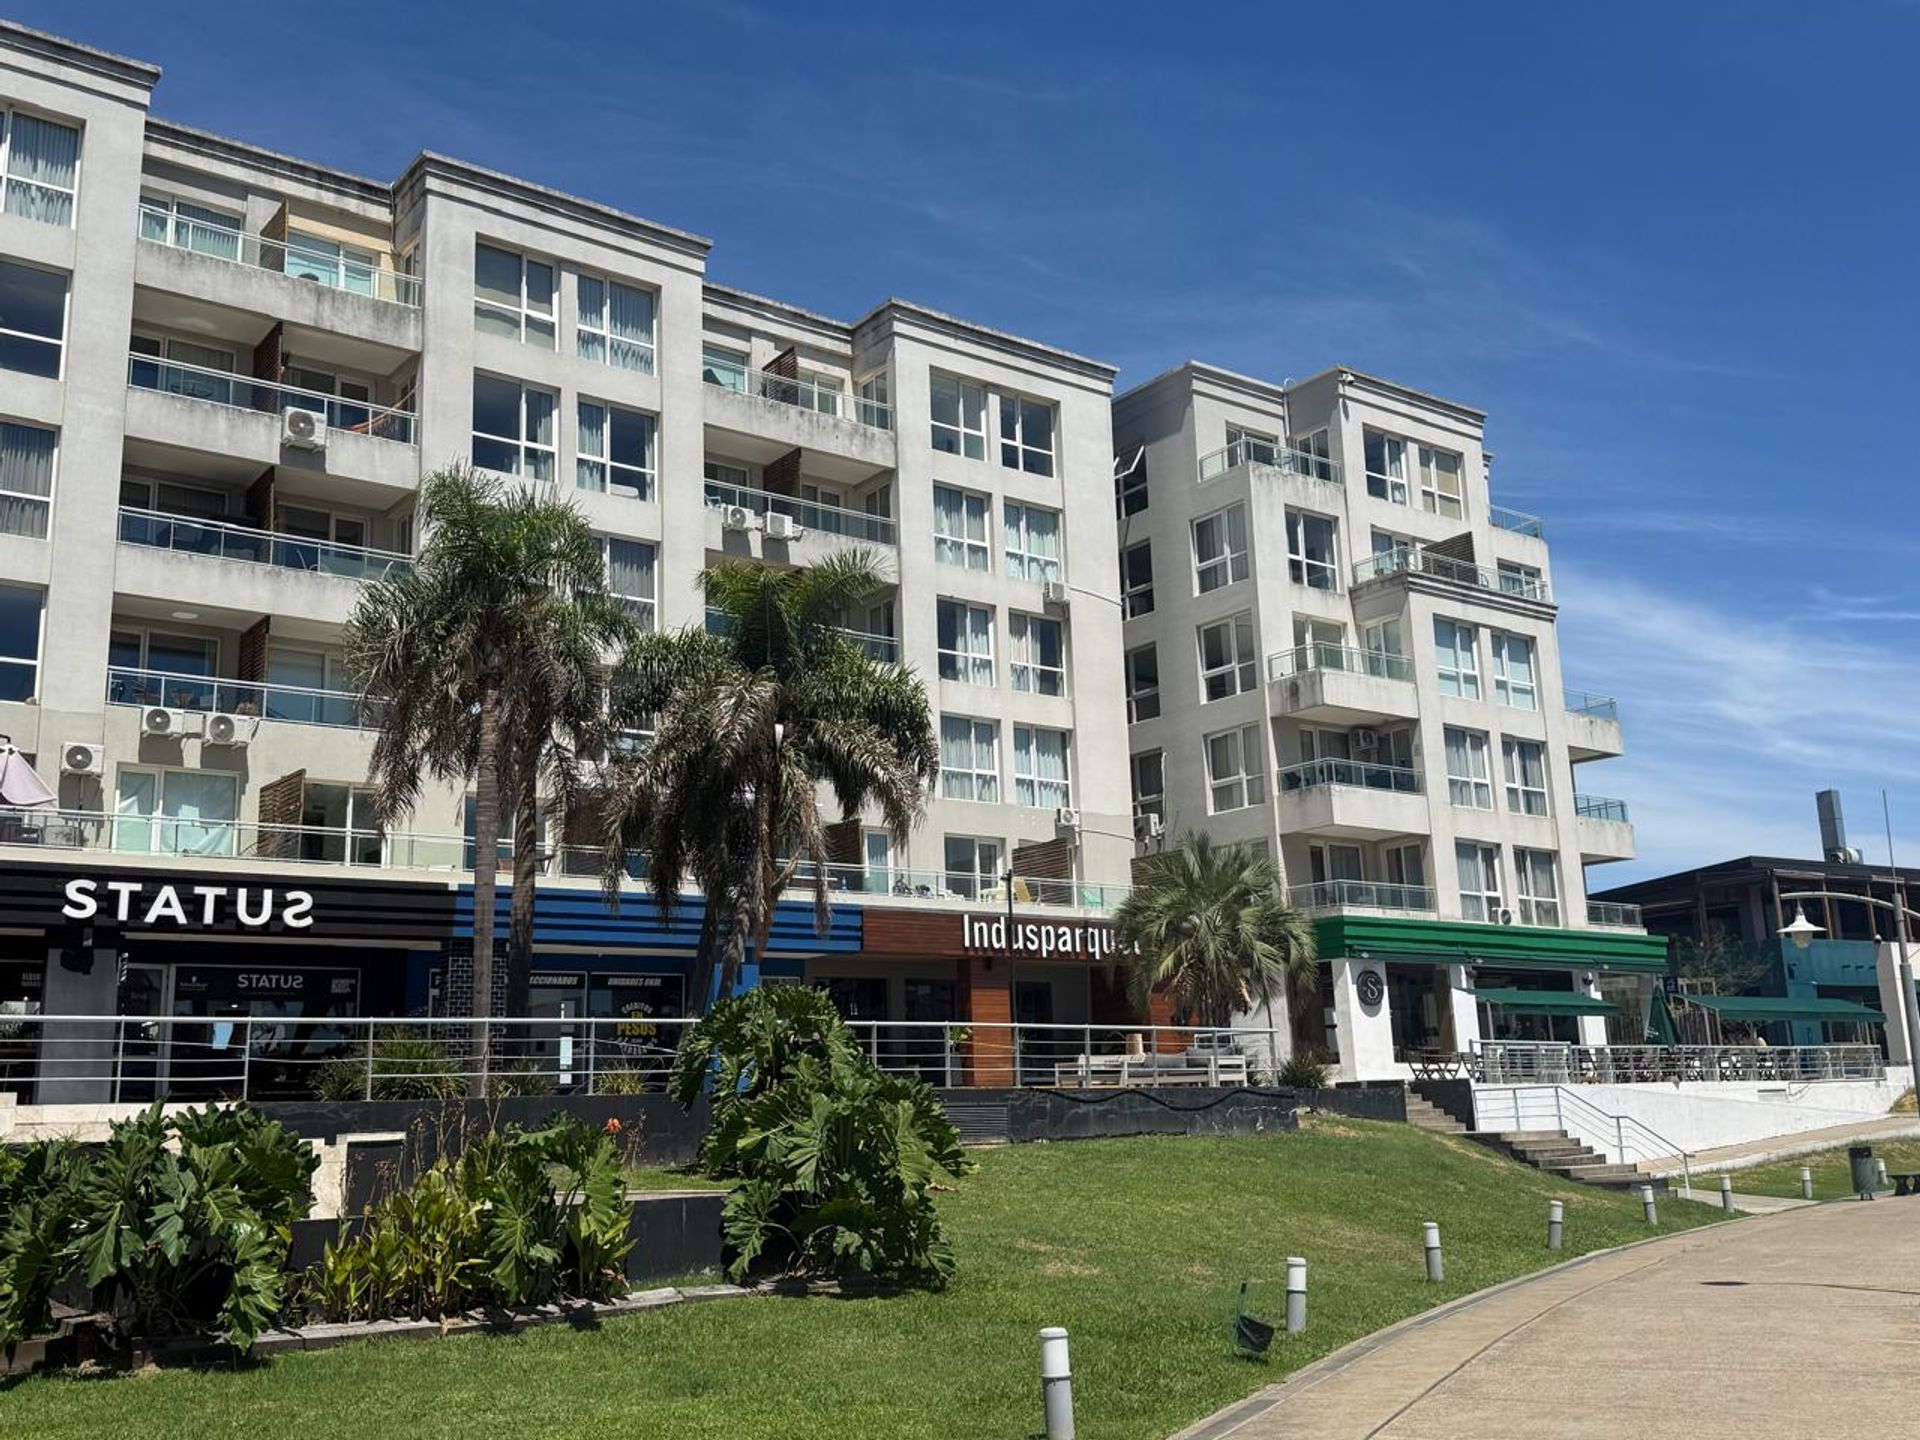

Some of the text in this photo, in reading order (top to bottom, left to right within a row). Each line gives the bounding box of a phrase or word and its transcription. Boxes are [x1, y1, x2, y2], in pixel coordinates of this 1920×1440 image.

[61, 878, 314, 929] STATUS
[963, 914, 1141, 960] Indusparqu
[237, 973, 304, 989] STATUS
[616, 1021, 657, 1036] PESOS
